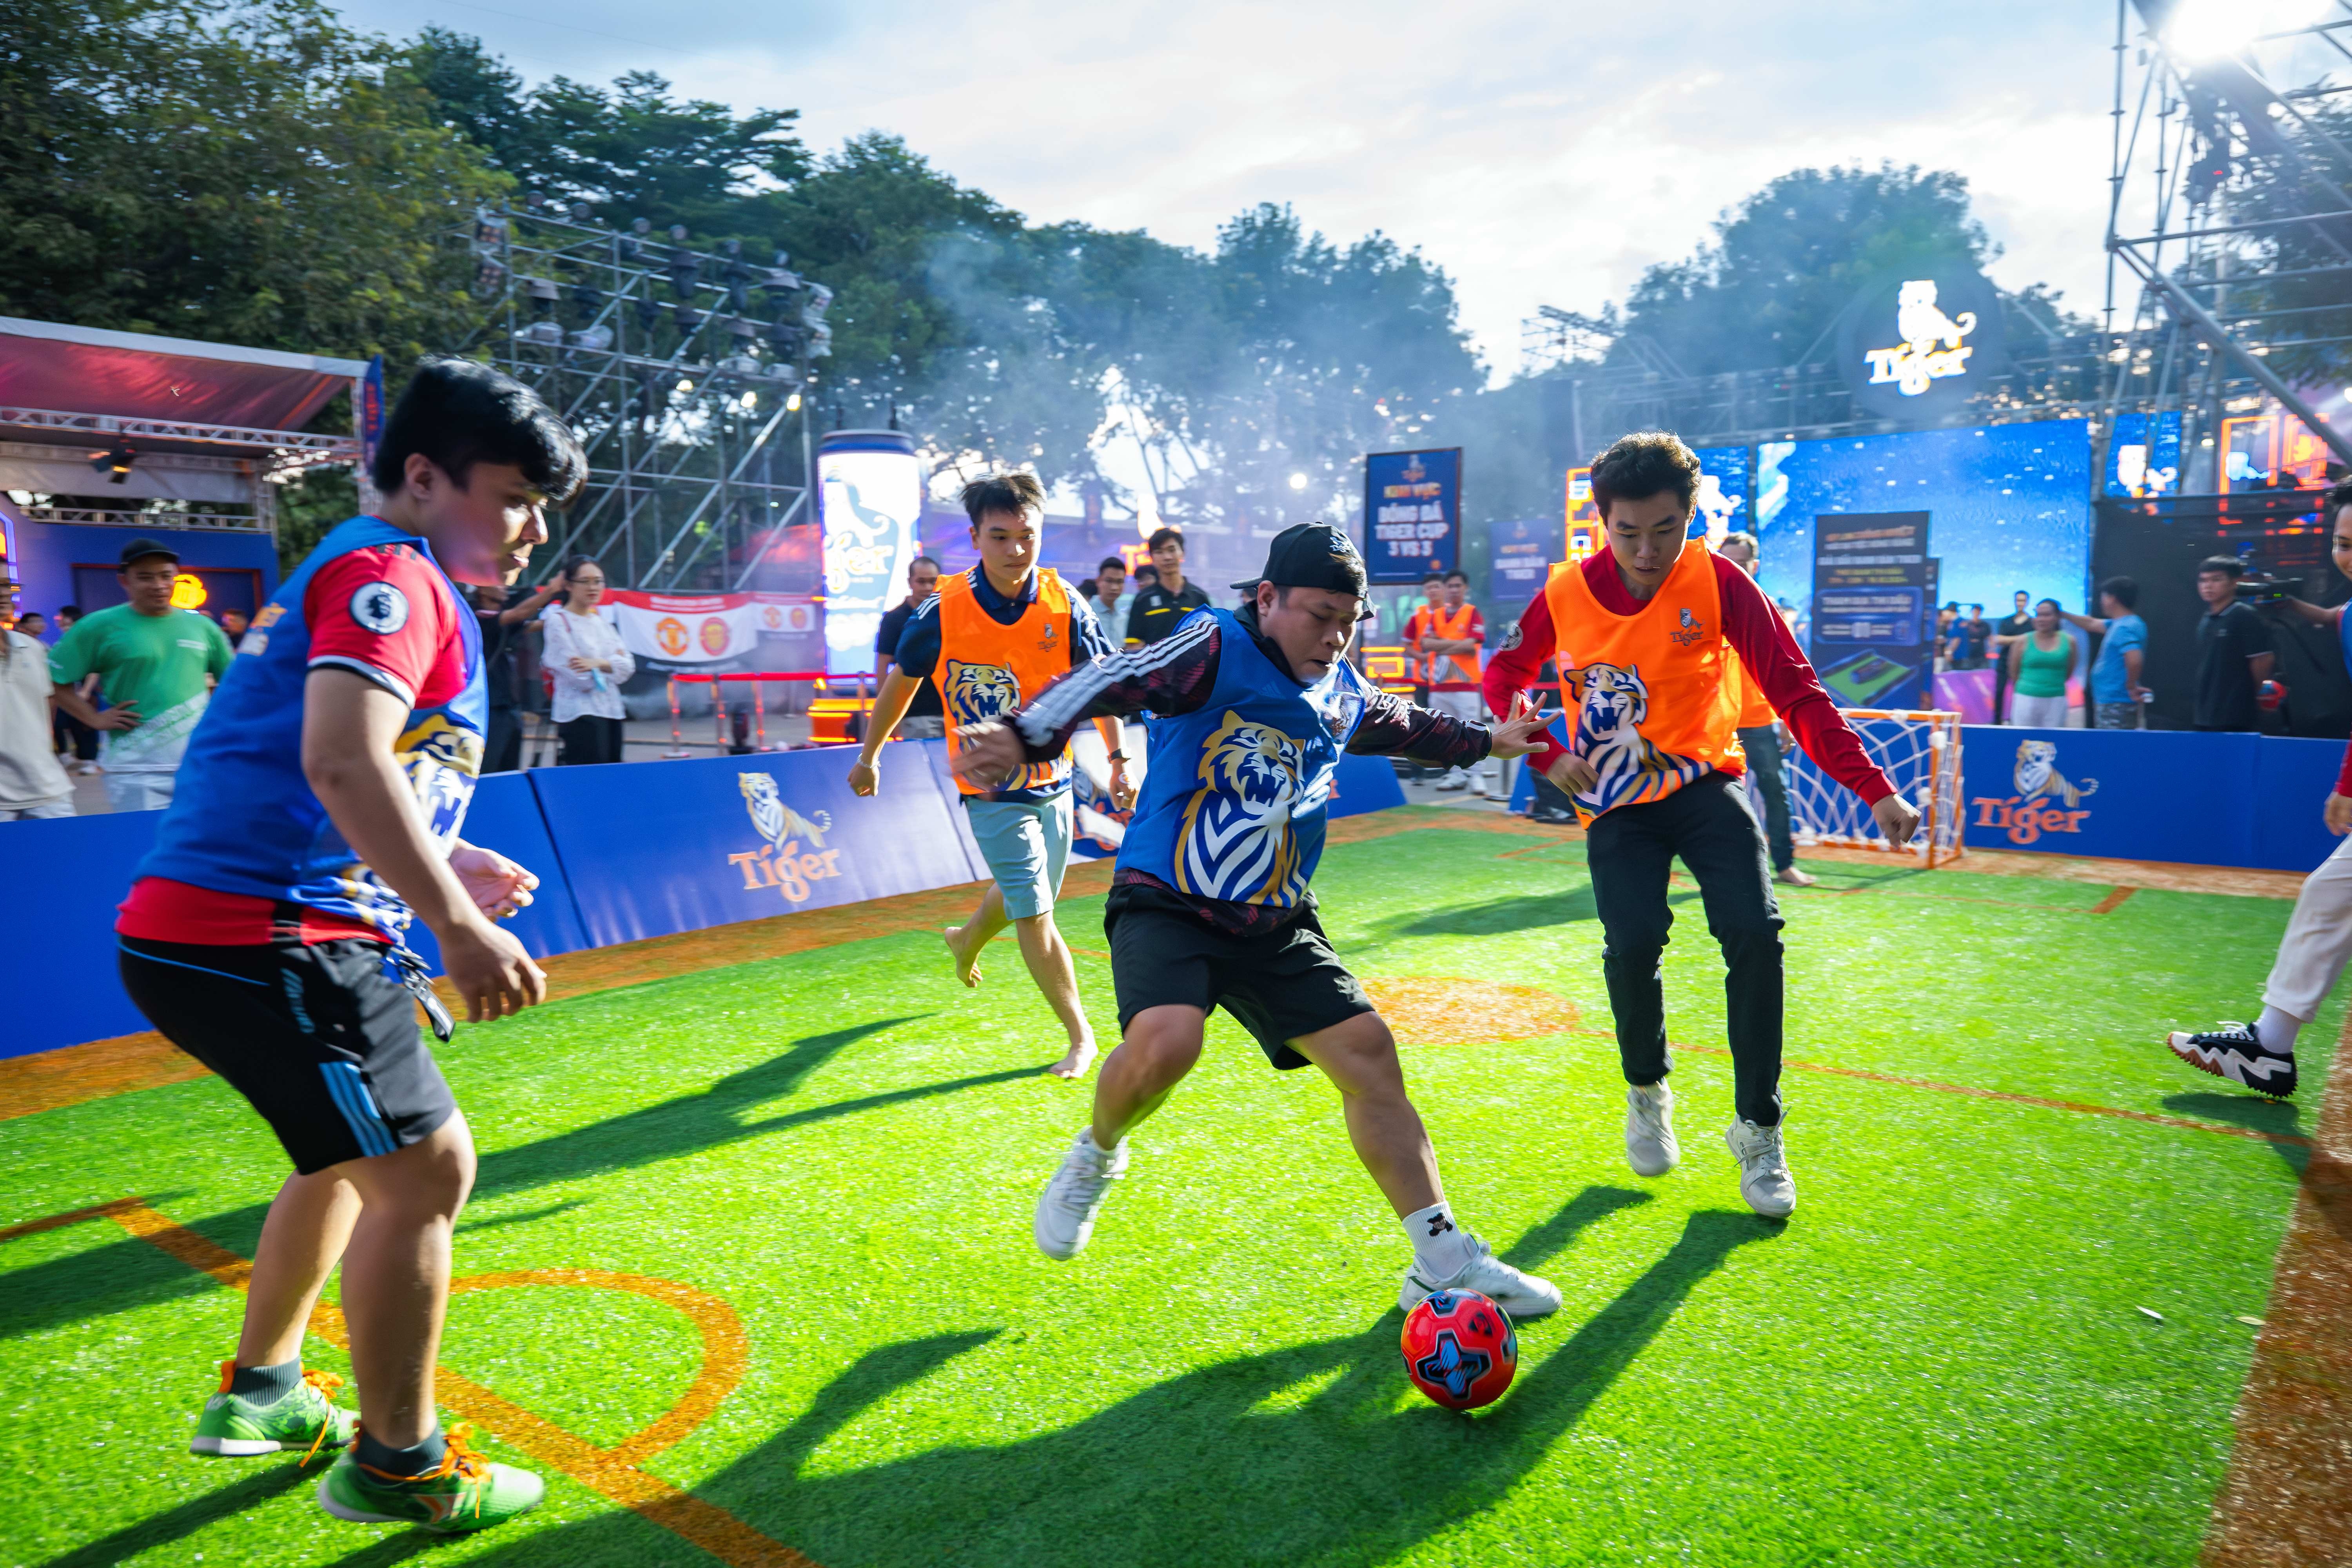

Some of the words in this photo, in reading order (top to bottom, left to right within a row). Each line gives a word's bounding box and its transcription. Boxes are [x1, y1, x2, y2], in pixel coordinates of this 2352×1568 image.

[1863, 339, 1973, 396] Tiger
[1374, 523, 1416, 540] TIGER
[1416, 522, 1449, 539] CUP
[1669, 628, 1704, 646] Tiger
[1971, 796, 2092, 845] Tiger
[728, 841, 842, 902] Tiger
